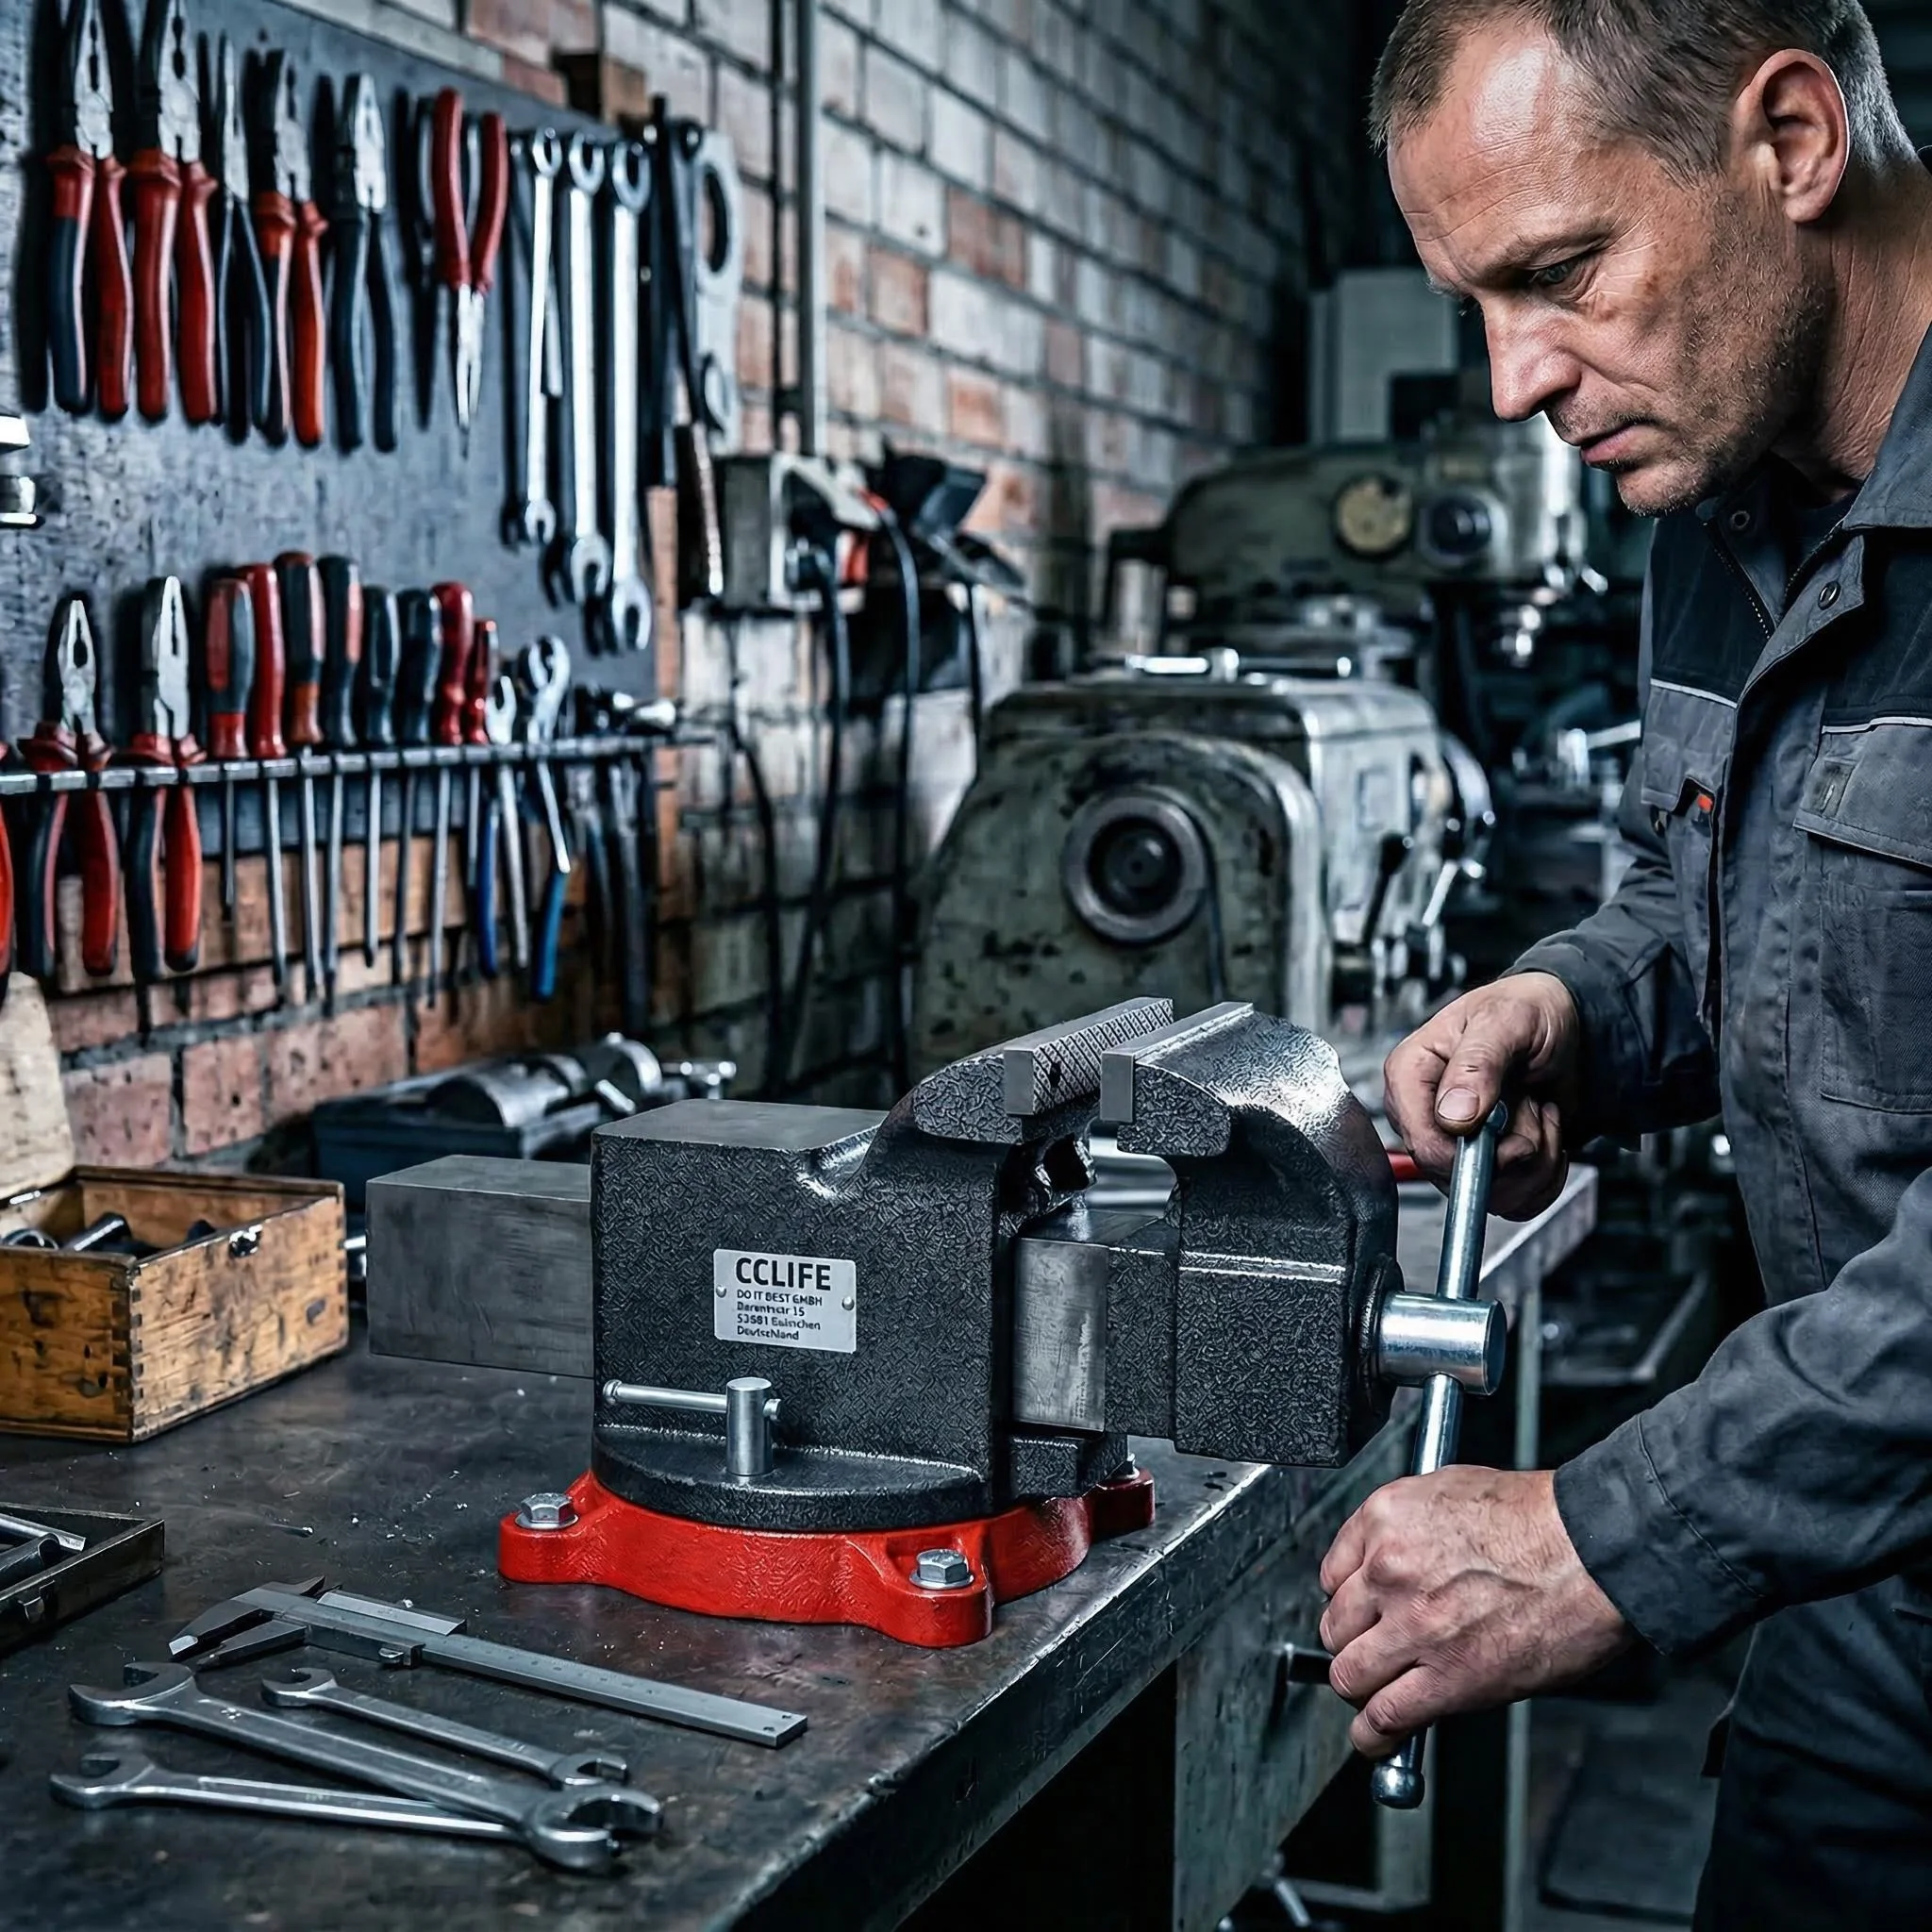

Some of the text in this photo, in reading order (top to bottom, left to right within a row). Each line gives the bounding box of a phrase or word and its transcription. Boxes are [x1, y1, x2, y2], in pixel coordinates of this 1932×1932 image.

[736, 1257, 831, 1291] CCLIFE
[737, 1289, 752, 1300] DO
[754, 1291, 763, 1301] IT
[765, 1291, 791, 1304] BEST
